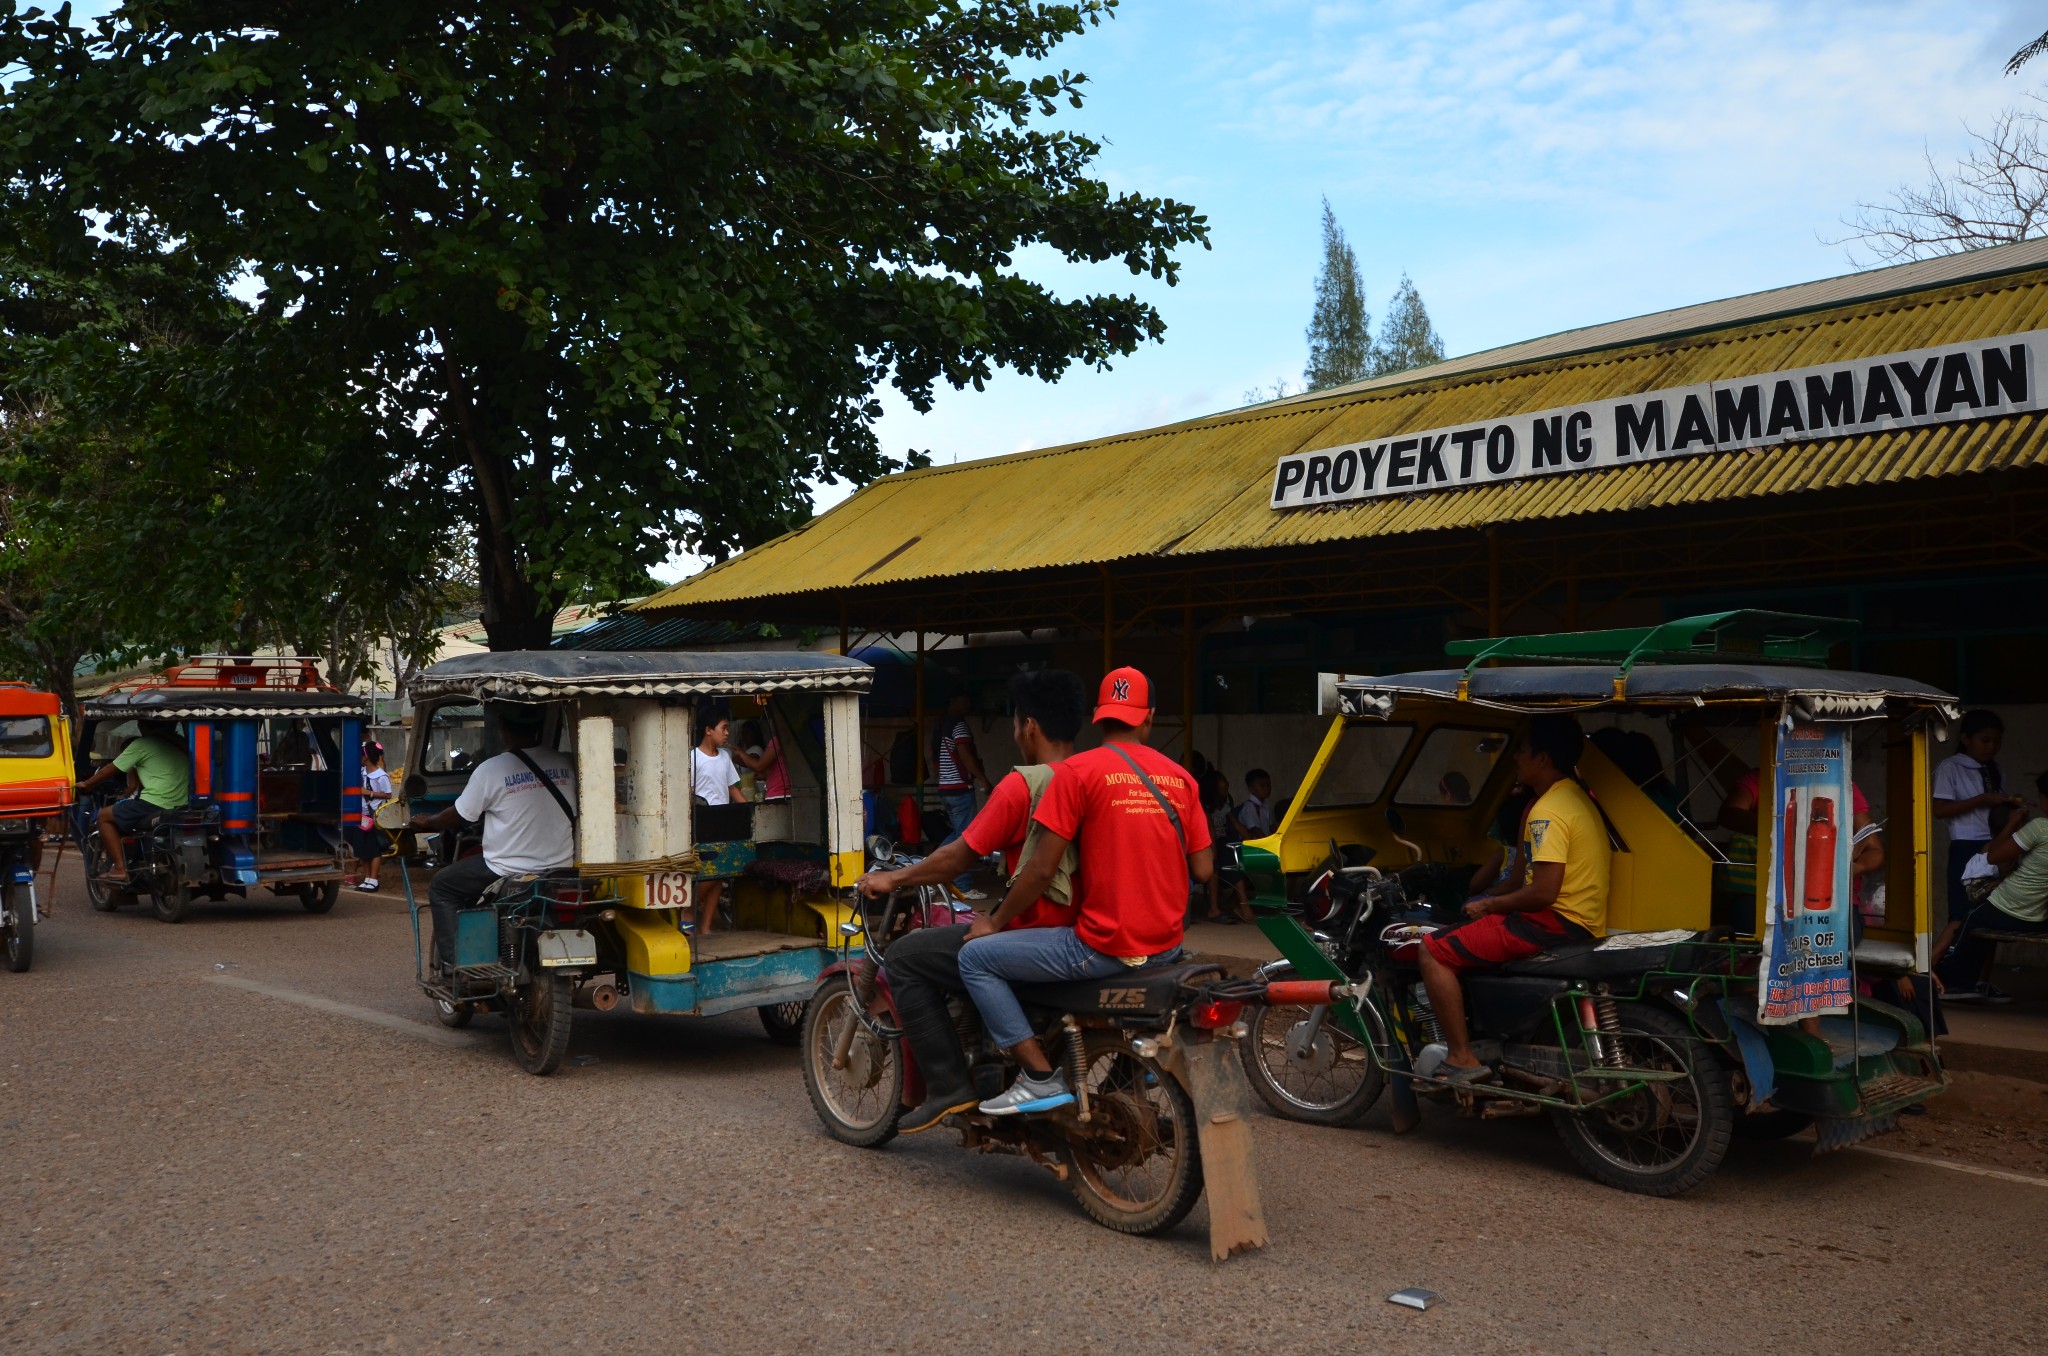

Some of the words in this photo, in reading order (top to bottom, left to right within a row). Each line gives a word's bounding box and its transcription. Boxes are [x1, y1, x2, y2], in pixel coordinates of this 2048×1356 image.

[1274, 424, 1515, 502] PROYEKTO
[1531, 410, 1593, 469] NG
[1614, 343, 2028, 458] MAMAMAYAN
[504, 772, 533, 787] ALAGANG
[1105, 773, 1142, 785] MOVING
[1147, 775, 1184, 789] ORWARD
[646, 872, 688, 906] 163
[1804, 916, 1813, 924] 11
[1817, 916, 1829, 924] KG
[1815, 933, 1834, 946] OFF
[1099, 988, 1147, 1004] 175
